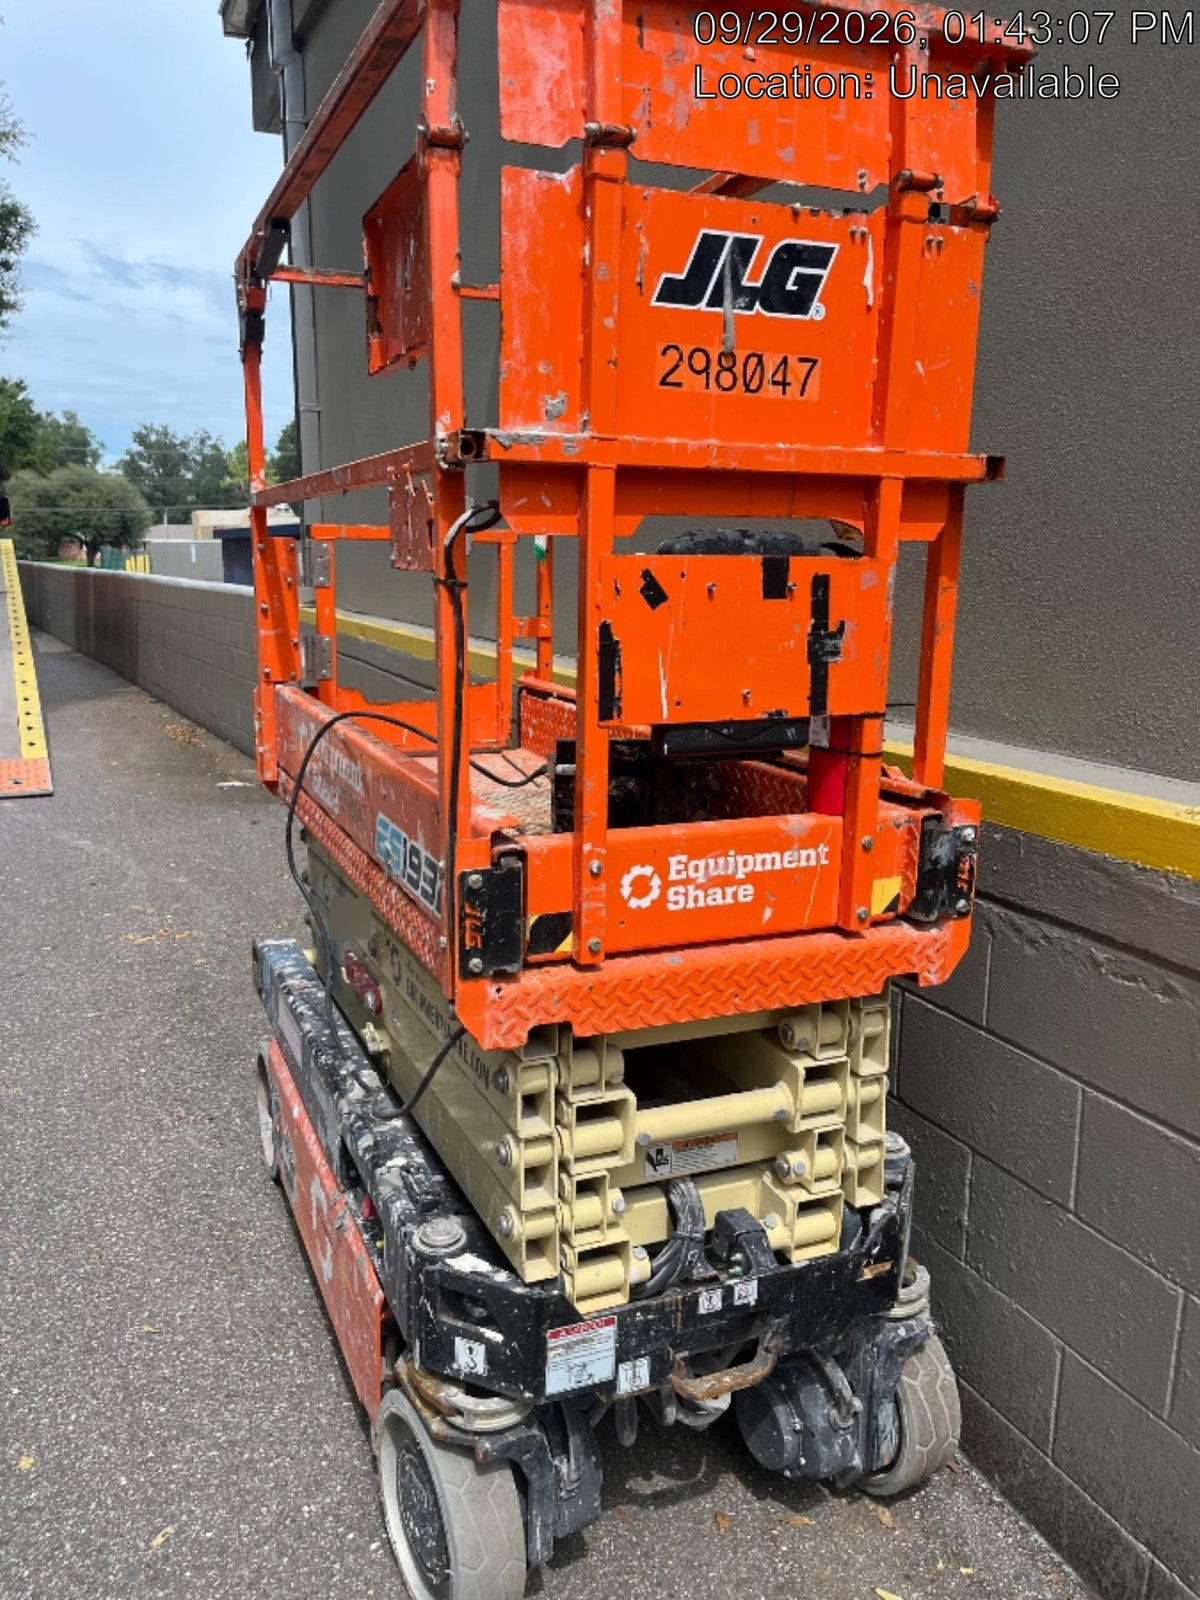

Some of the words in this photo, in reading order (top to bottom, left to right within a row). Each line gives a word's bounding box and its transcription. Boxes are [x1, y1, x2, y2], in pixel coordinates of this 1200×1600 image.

[658, 344, 819, 397] 298047
[667, 843, 830, 884] Equipment
[666, 883, 755, 911] Share
